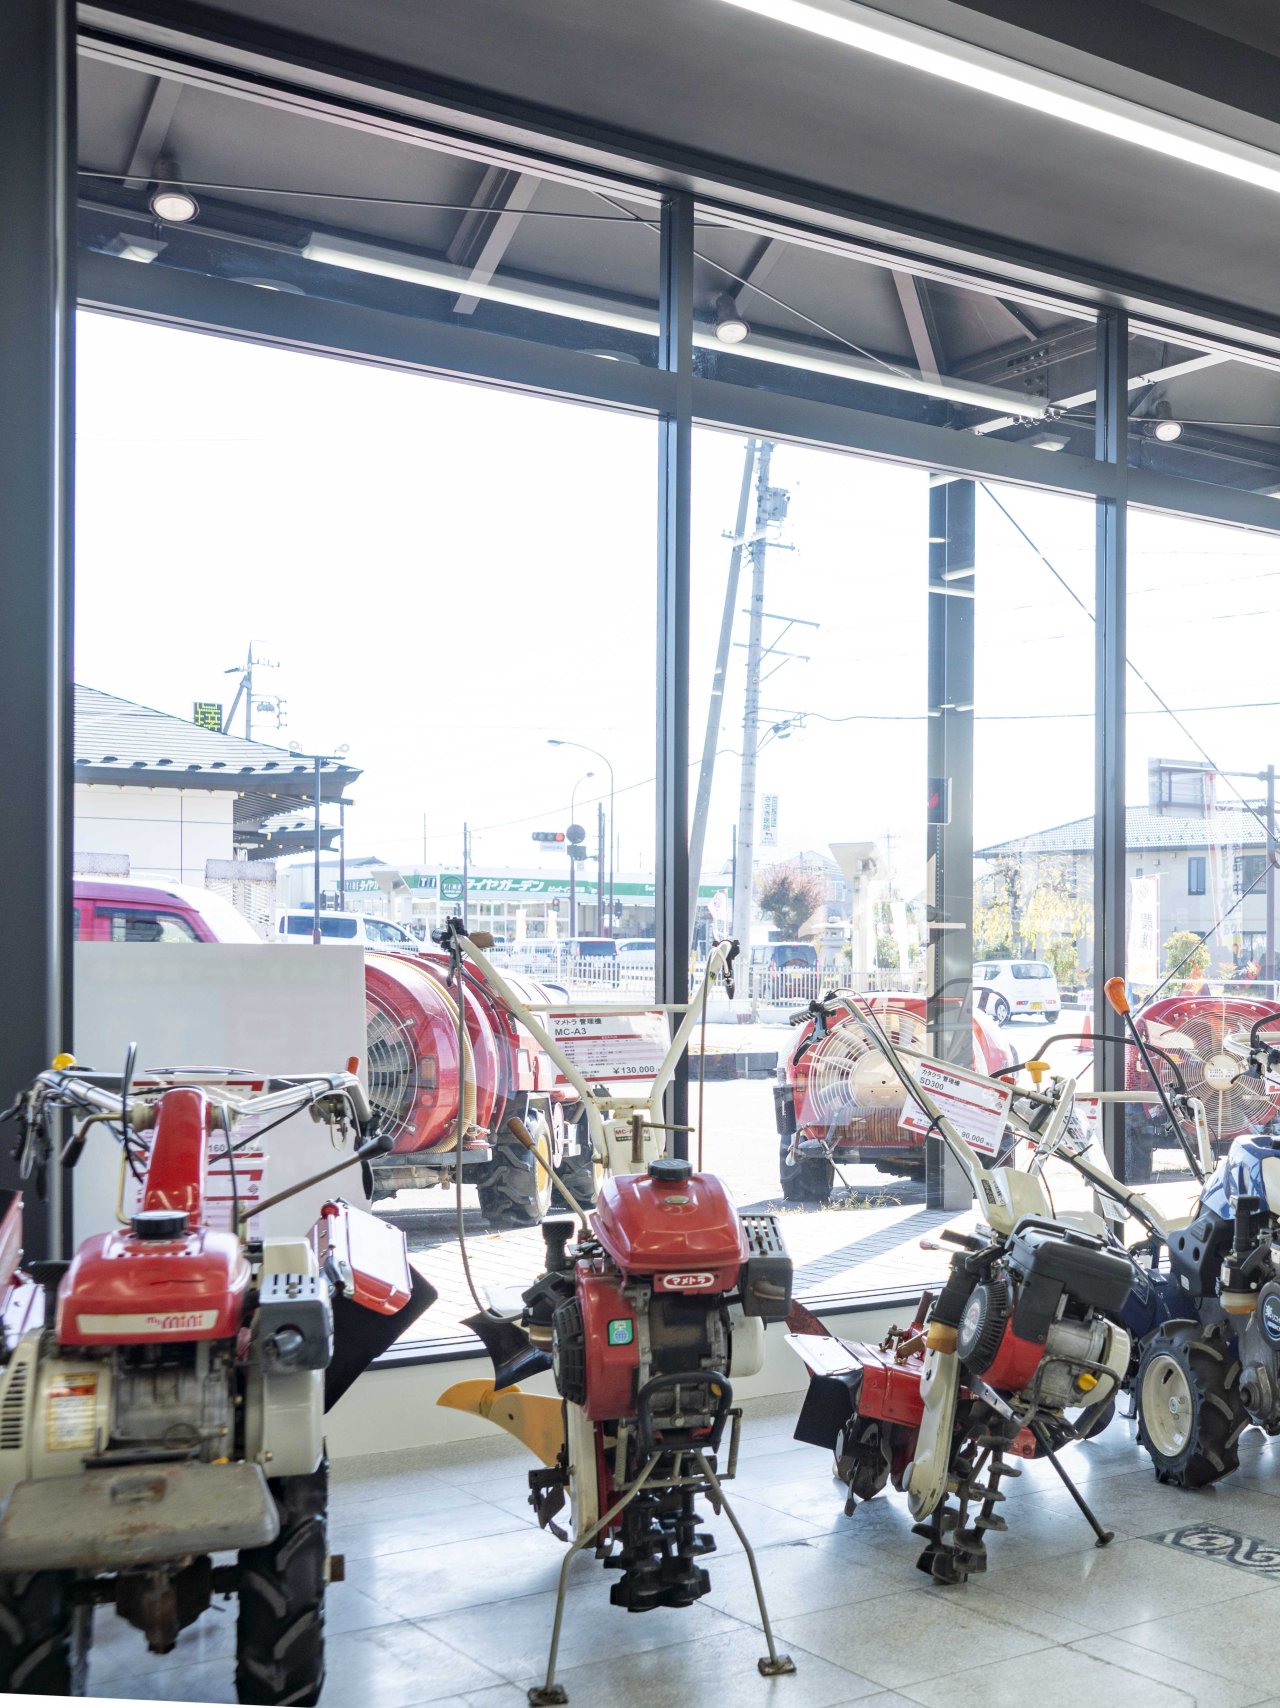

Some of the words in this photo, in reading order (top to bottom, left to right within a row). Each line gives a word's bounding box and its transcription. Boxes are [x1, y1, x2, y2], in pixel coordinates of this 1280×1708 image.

[554, 1018, 577, 1026] マメトラ
[579, 1017, 602, 1025] 管理機
[554, 1027, 587, 1036] MC-A3
[612, 1065, 655, 1075] ¥130,000
[921, 1069, 941, 1080] カタクラ
[943, 1076, 961, 1087] 管理機
[919, 1076, 944, 1091] SD300
[672, 1276, 706, 1285] マメトラ
[162, 1315, 203, 1329] mini
